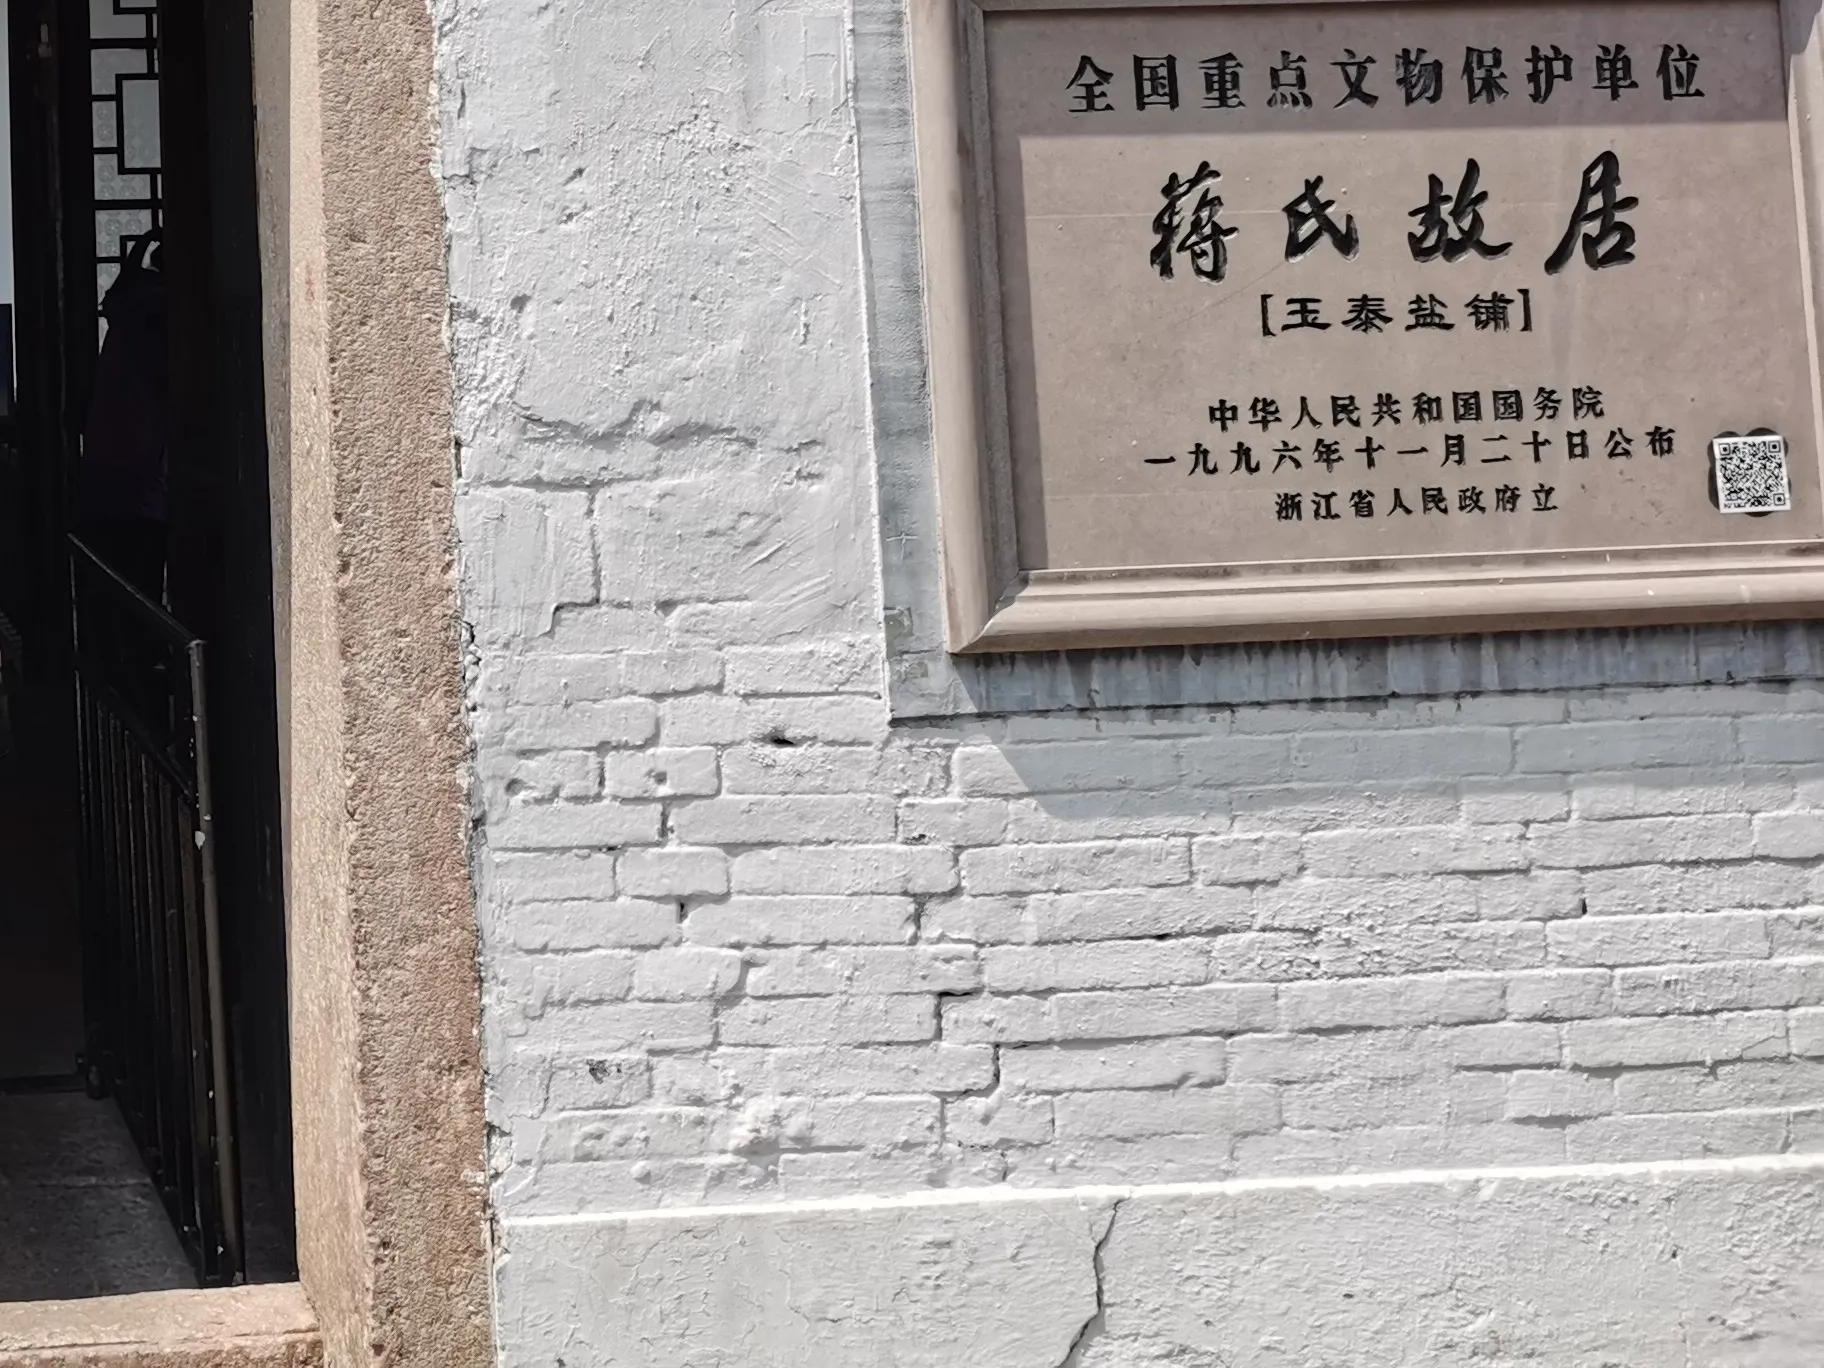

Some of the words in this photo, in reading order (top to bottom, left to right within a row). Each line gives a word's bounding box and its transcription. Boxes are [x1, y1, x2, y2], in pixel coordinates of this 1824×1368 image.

[1065, 43, 1706, 115] 全国重点文物保护单位
[1149, 150, 1640, 284] 蒋氏故居
[1208, 385, 1606, 433] 中华人民共和国国务院
[1143, 425, 1677, 476] 一九九六年十一月二十日公布
[1274, 482, 1559, 522] 浙江省人民政府立
